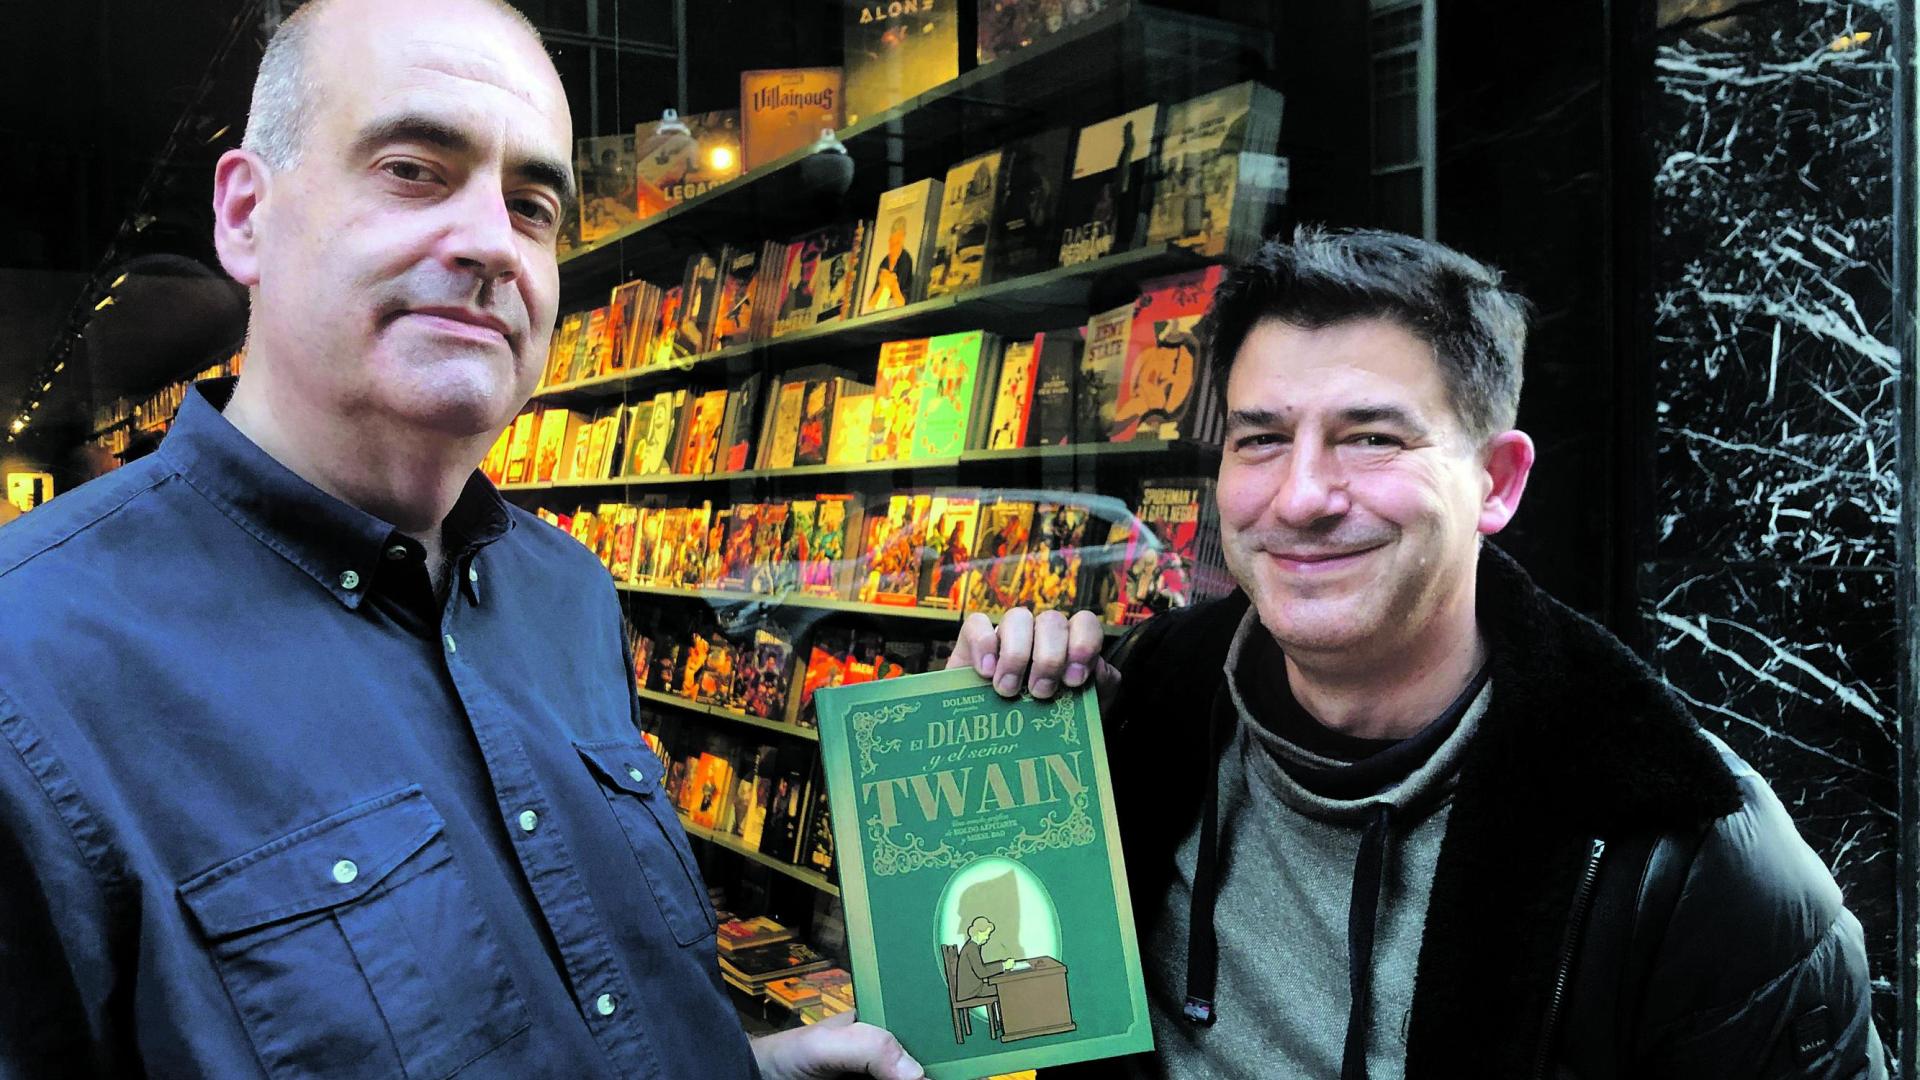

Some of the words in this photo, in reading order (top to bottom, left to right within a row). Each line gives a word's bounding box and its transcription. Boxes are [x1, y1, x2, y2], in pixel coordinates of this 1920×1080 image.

[859, 0, 934, 24] ALONE
[754, 85, 833, 112] Villainous
[942, 694, 985, 708] DOLMEN
[927, 709, 1024, 749] DIABLO
[922, 755, 941, 772] y
[947, 745, 967, 763] el
[967, 742, 1019, 760] señor
[862, 751, 1089, 830] TWAIN
